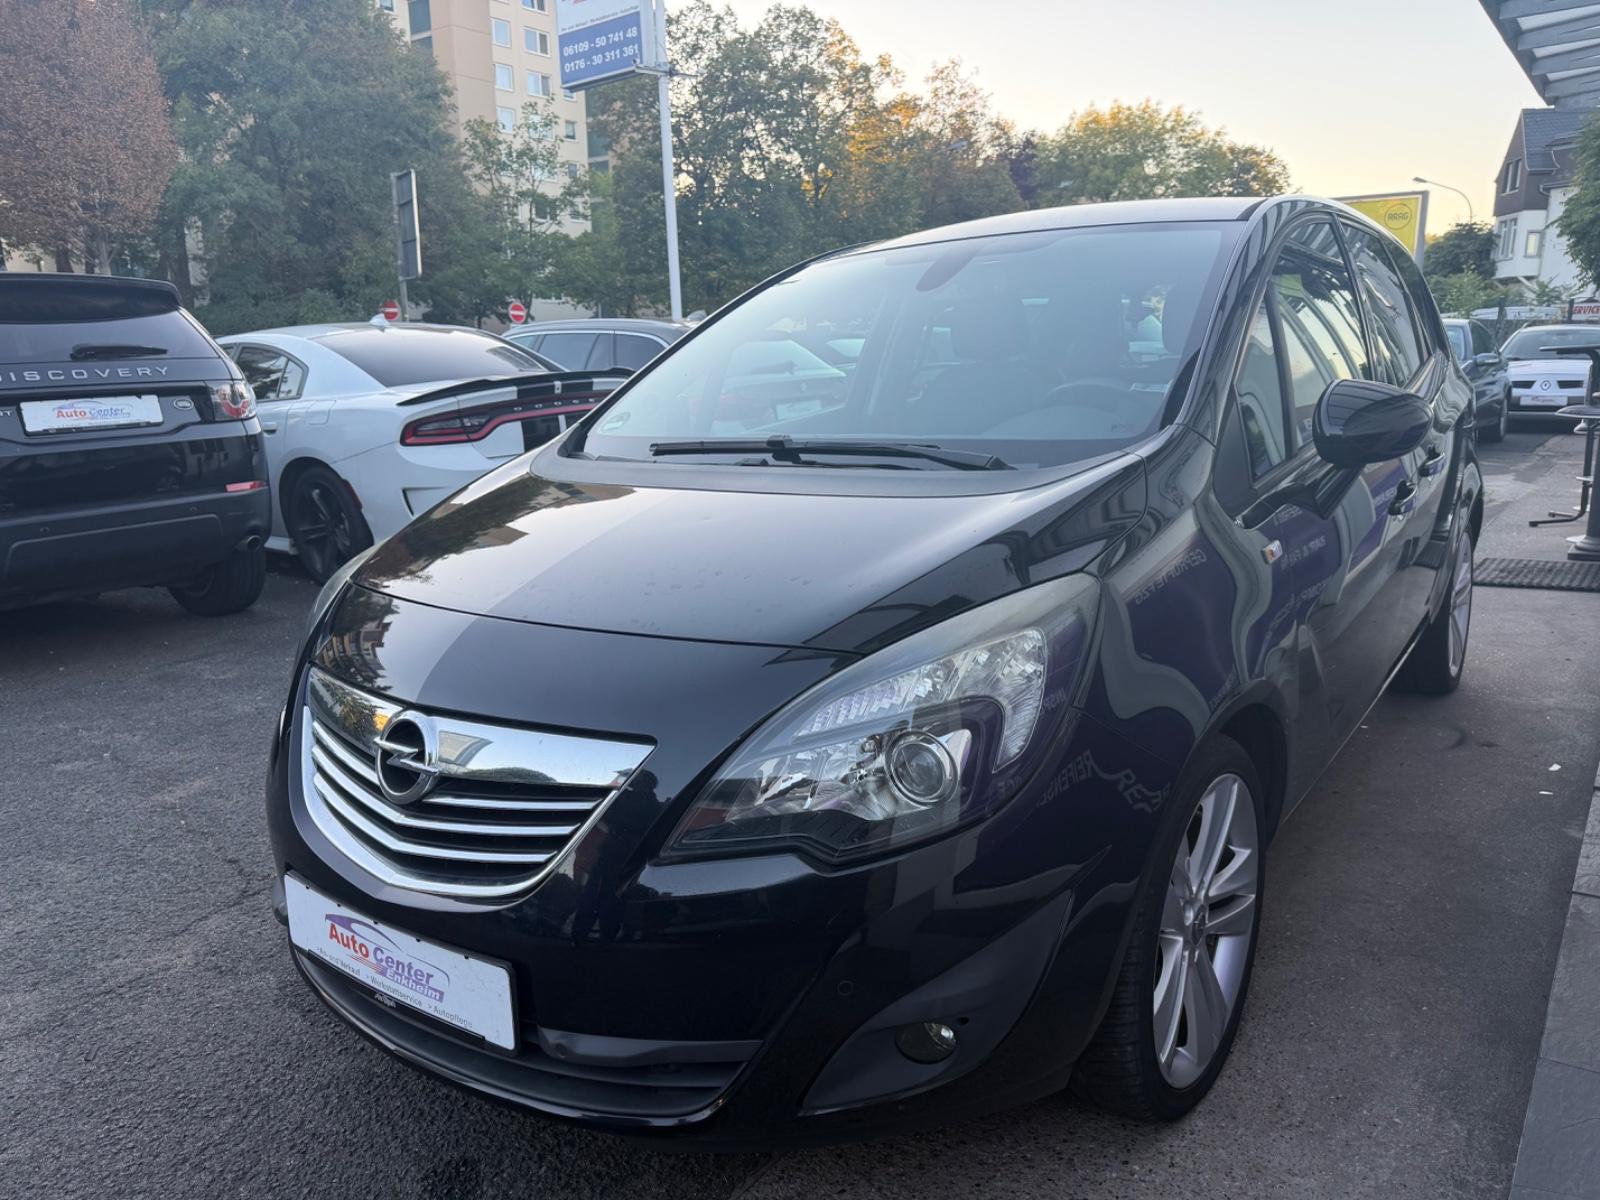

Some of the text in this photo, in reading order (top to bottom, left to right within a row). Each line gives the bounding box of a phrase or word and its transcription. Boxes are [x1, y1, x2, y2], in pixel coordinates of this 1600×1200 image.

[563, 41, 589, 57] 06109
[595, 36, 606, 48] 50
[608, 32, 624, 44] 741
[626, 26, 638, 38] 48
[564, 58, 585, 72] 0176
[592, 54, 603, 66] 30
[604, 49, 620, 62] 311
[622, 44, 639, 57] 361
[1570, 305, 1600, 315] ERVICE
[55, 408, 87, 419] Auto
[328, 922, 434, 986] Auto Center
[385, 966, 441, 1001] Enkheim
